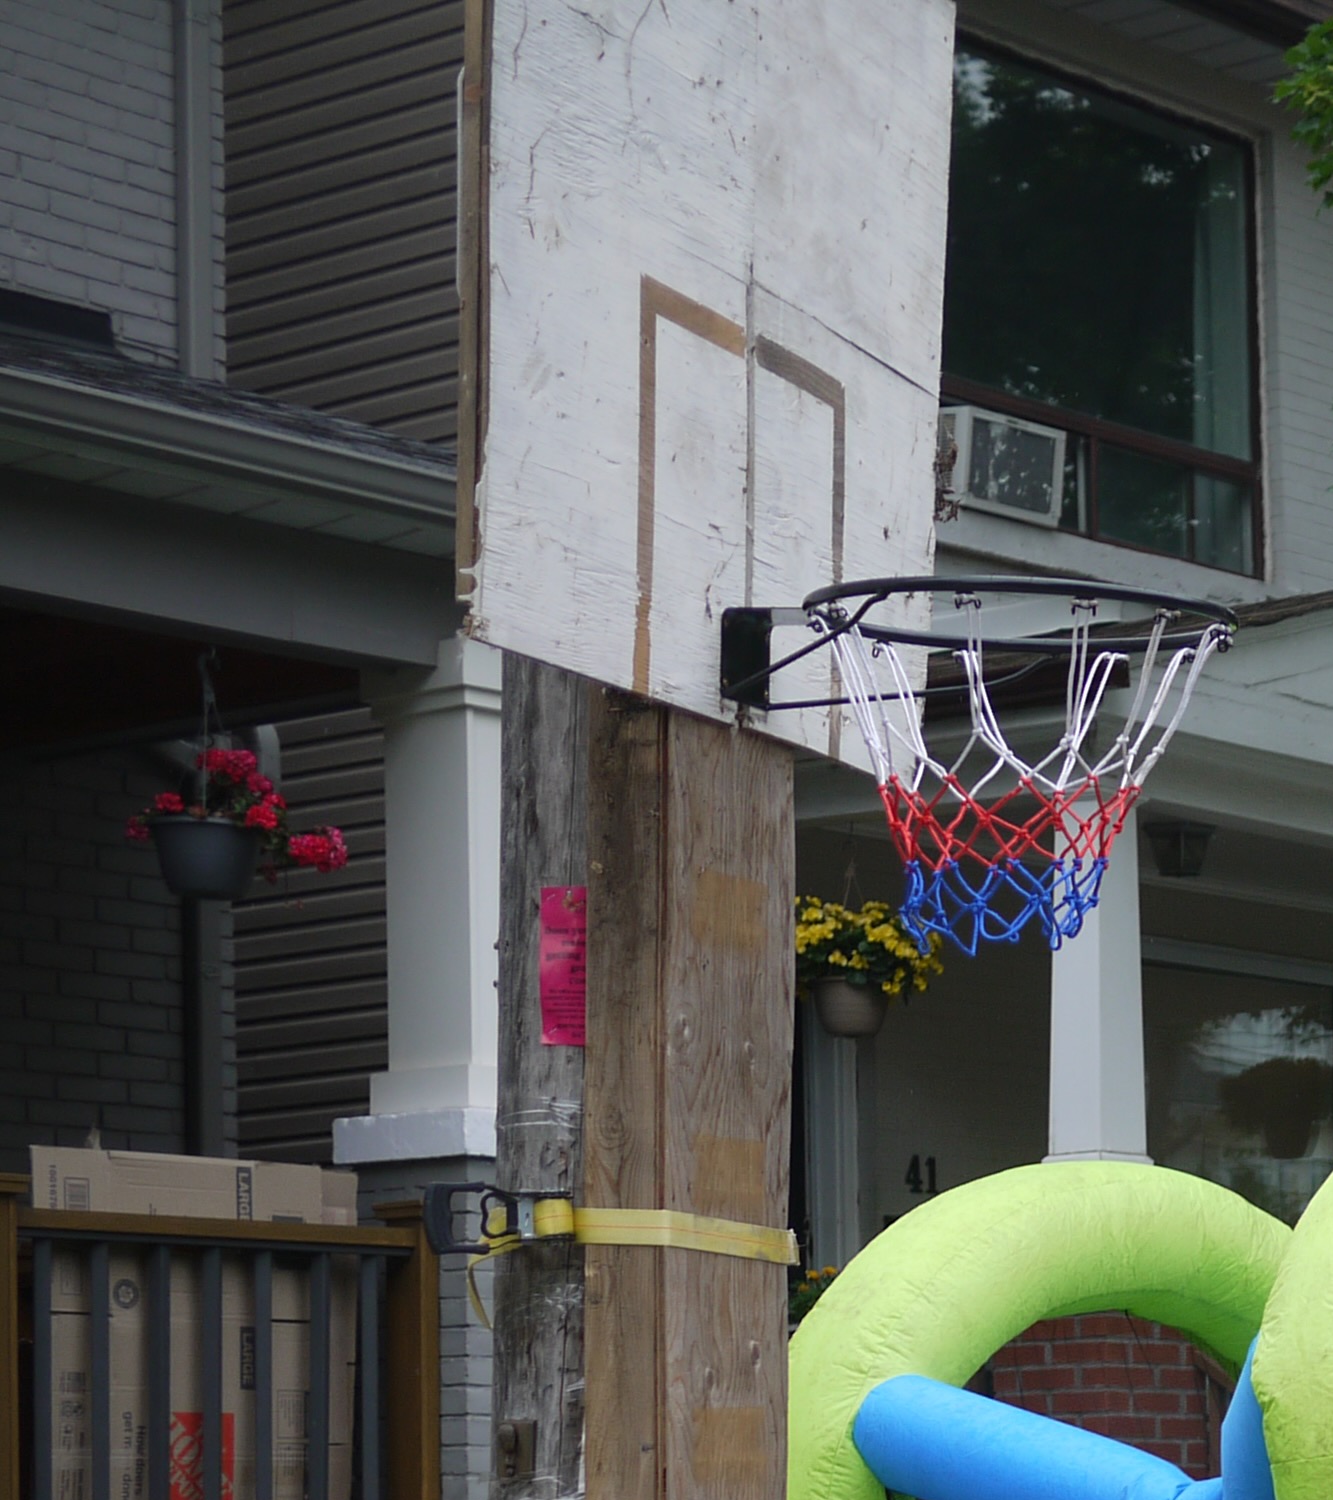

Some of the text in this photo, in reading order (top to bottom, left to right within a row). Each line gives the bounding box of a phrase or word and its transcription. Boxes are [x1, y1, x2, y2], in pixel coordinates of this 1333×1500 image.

[904, 1153, 938, 1195] 41
[243, 1332, 254, 1385] LARGE
[134, 1458, 145, 1497] doers
